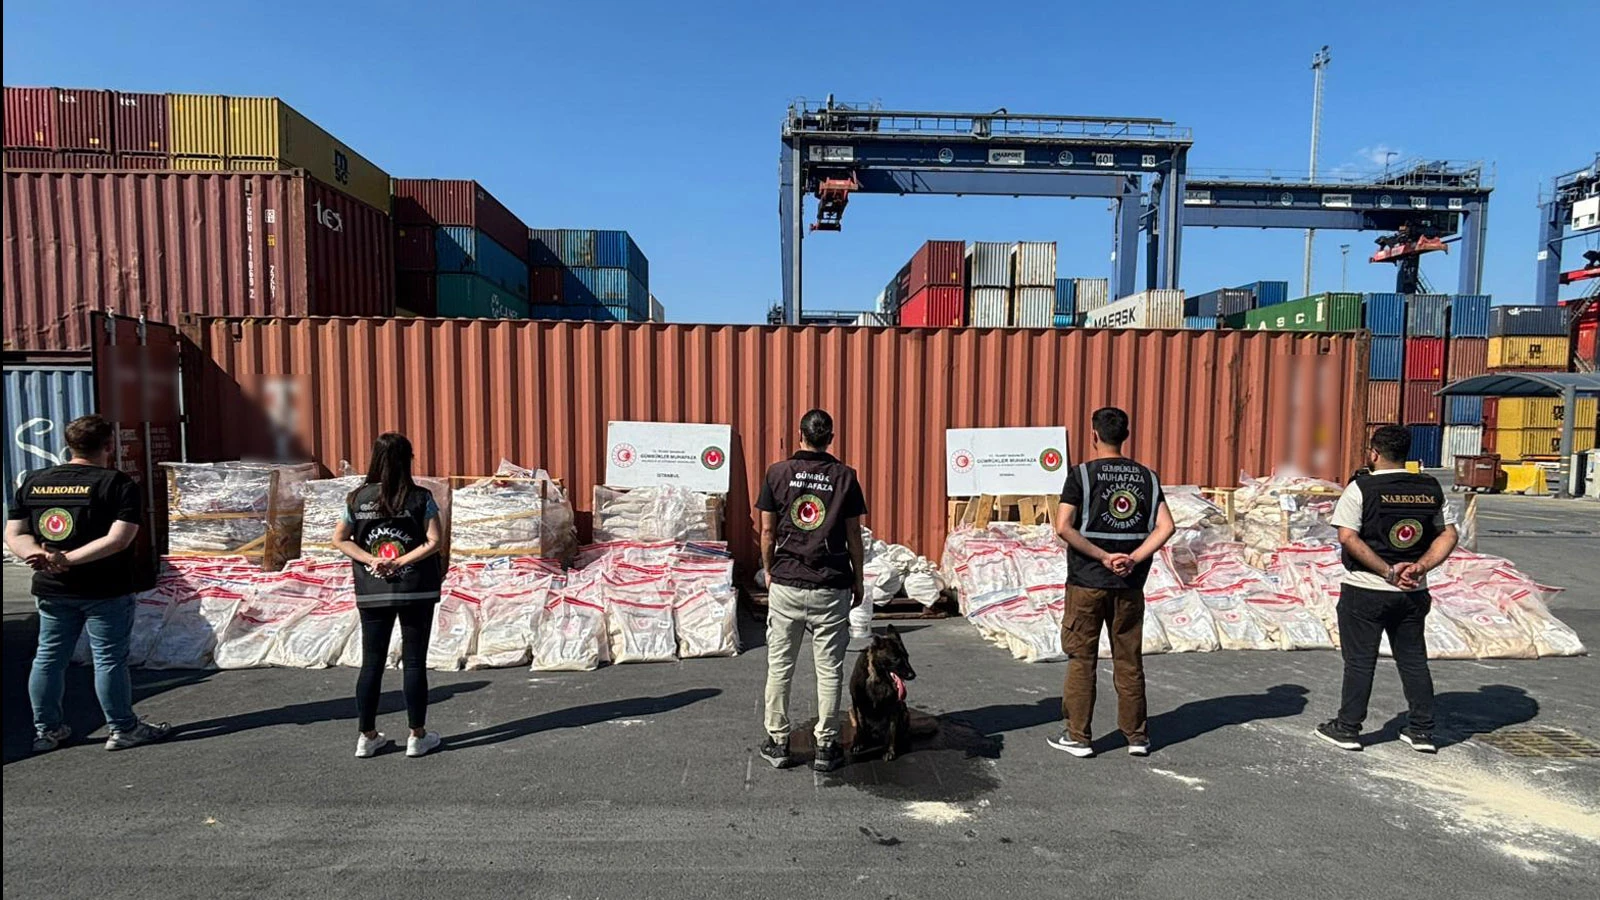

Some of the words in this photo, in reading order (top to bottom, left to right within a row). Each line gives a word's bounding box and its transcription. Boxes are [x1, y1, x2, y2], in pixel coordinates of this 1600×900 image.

[1143, 156, 1154, 165] 13
[1097, 472, 1145, 483] MUHAFAZA
[1381, 494, 1436, 504] NARKOKİM
